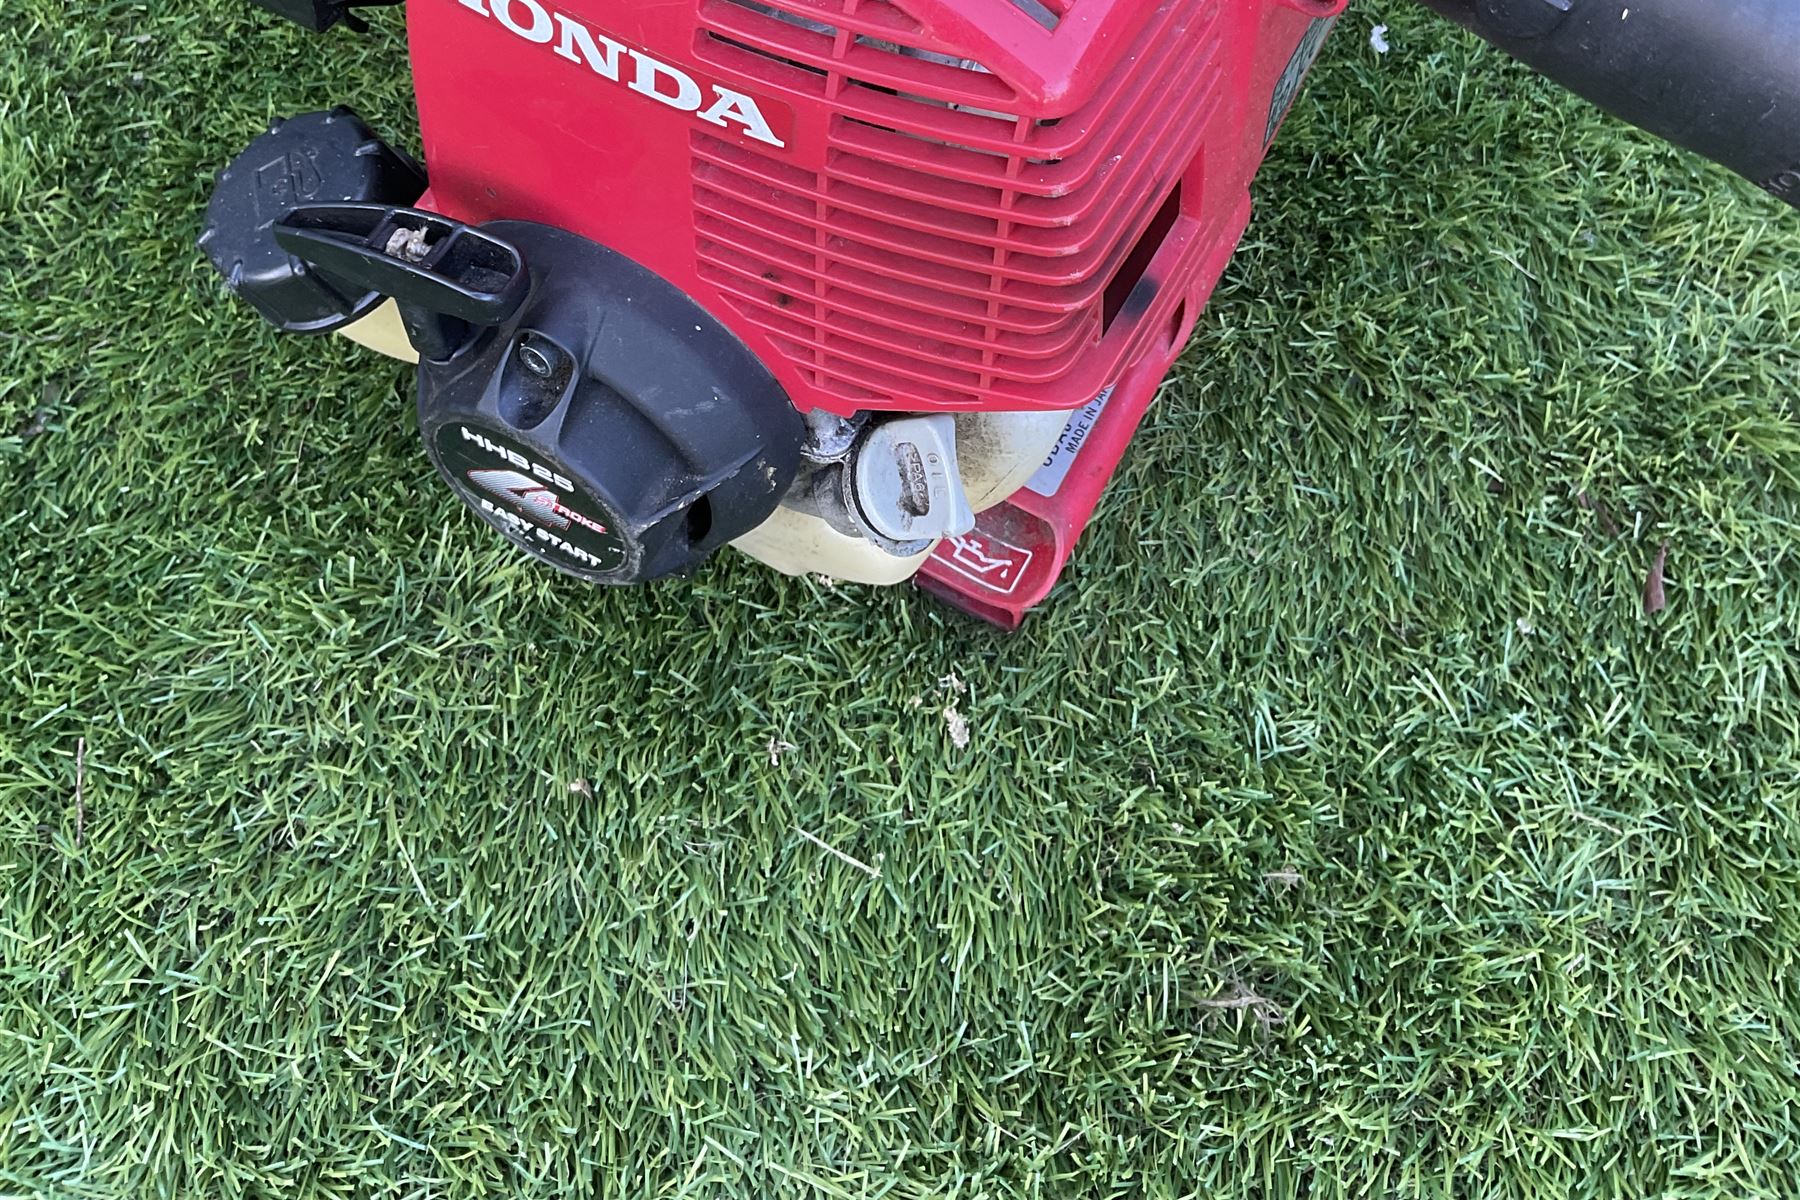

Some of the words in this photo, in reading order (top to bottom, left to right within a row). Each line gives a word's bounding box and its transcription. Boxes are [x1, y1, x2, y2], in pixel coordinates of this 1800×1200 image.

[460, 426, 575, 493] HHB25
[1065, 421, 1089, 454] MADE
[1083, 406, 1097, 421] IN
[481, 499, 534, 531] EASY
[536, 527, 602, 567] START
